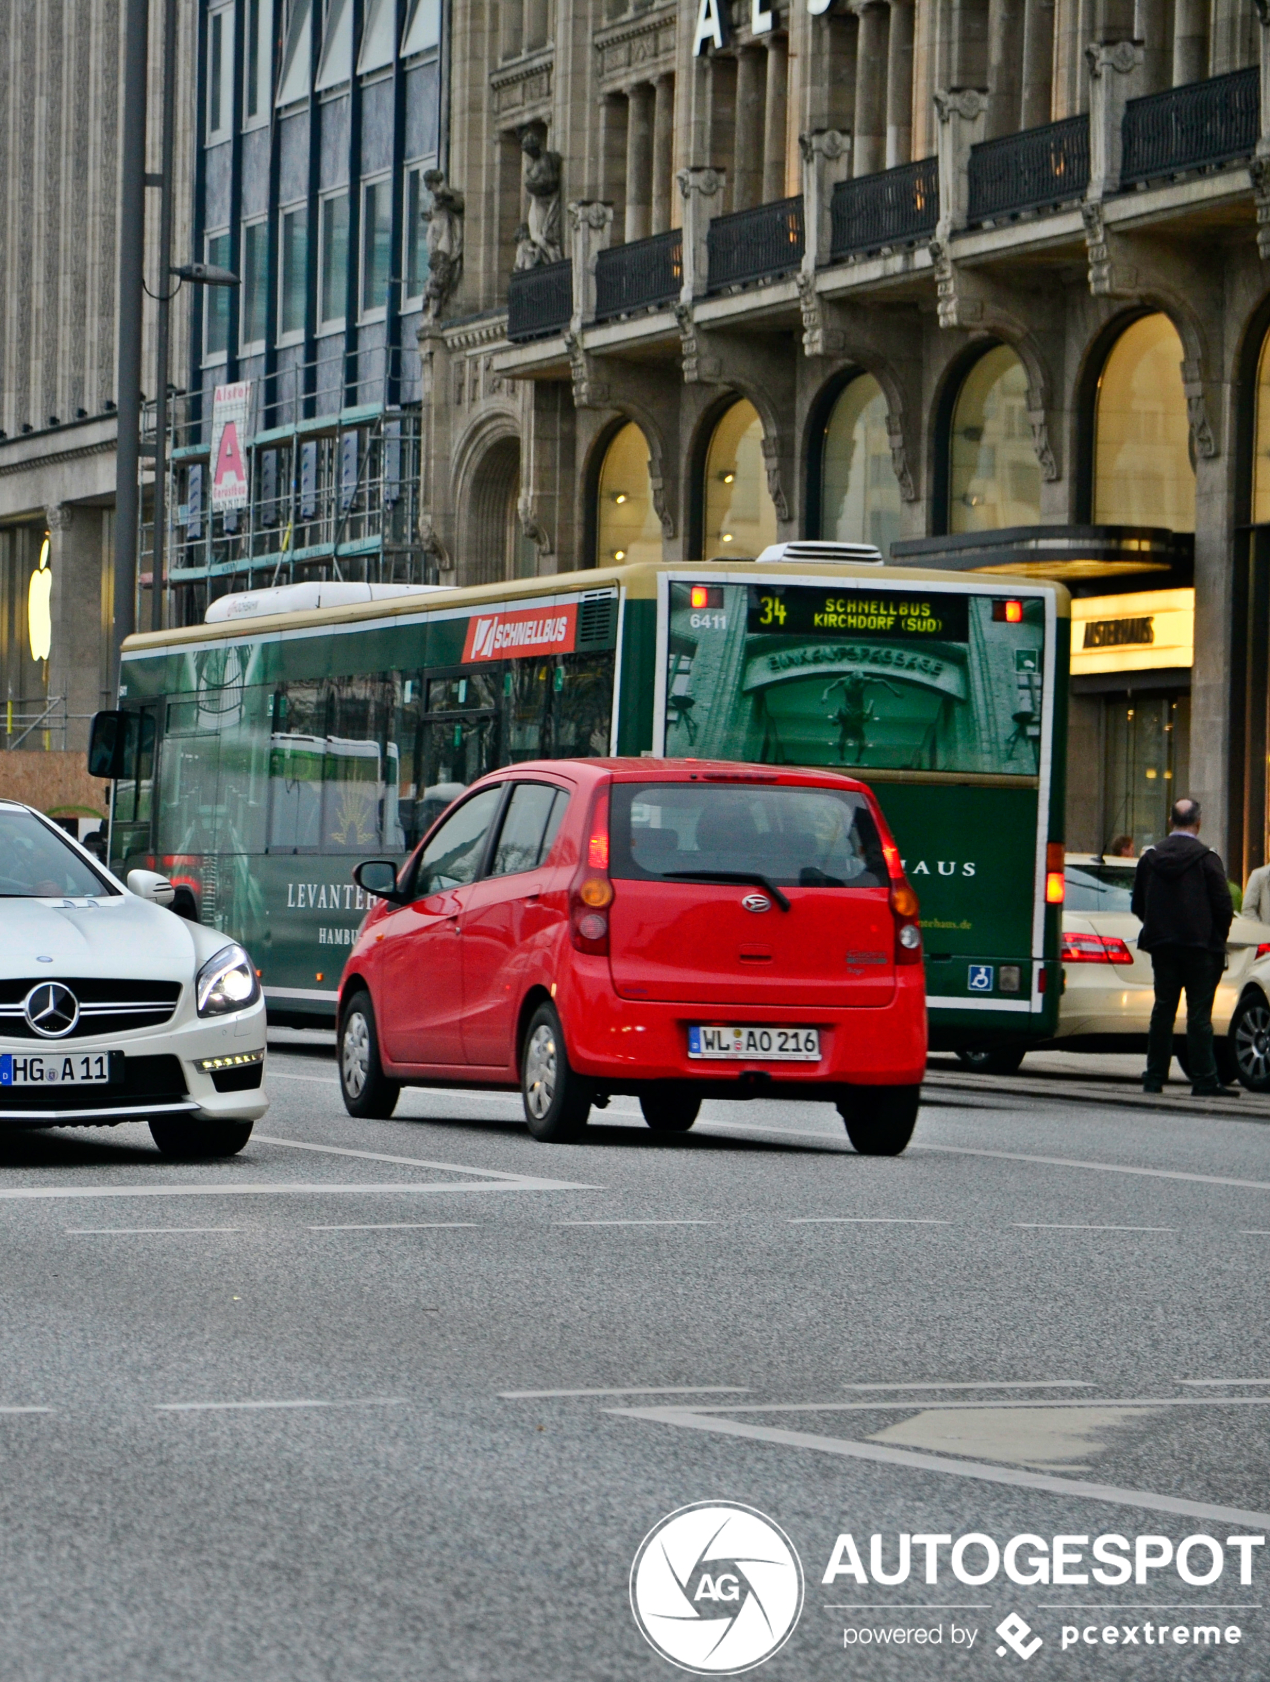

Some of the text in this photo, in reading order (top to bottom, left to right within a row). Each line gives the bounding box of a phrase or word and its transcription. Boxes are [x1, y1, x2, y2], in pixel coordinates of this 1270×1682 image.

[692, 0, 831, 57] AL
[214, 421, 245, 485] A
[689, 613, 727, 630] 6411
[759, 596, 931, 625] 34 SCHNELLBUS
[813, 613, 895, 630] KIRCHDORF
[494, 616, 568, 649] SCHNELLBUS
[900, 860, 976, 877] AUS
[703, 1029, 730, 1051] WL
[777, 1031, 816, 1053] 216
[12, 1056, 107, 1082] HG A 11
